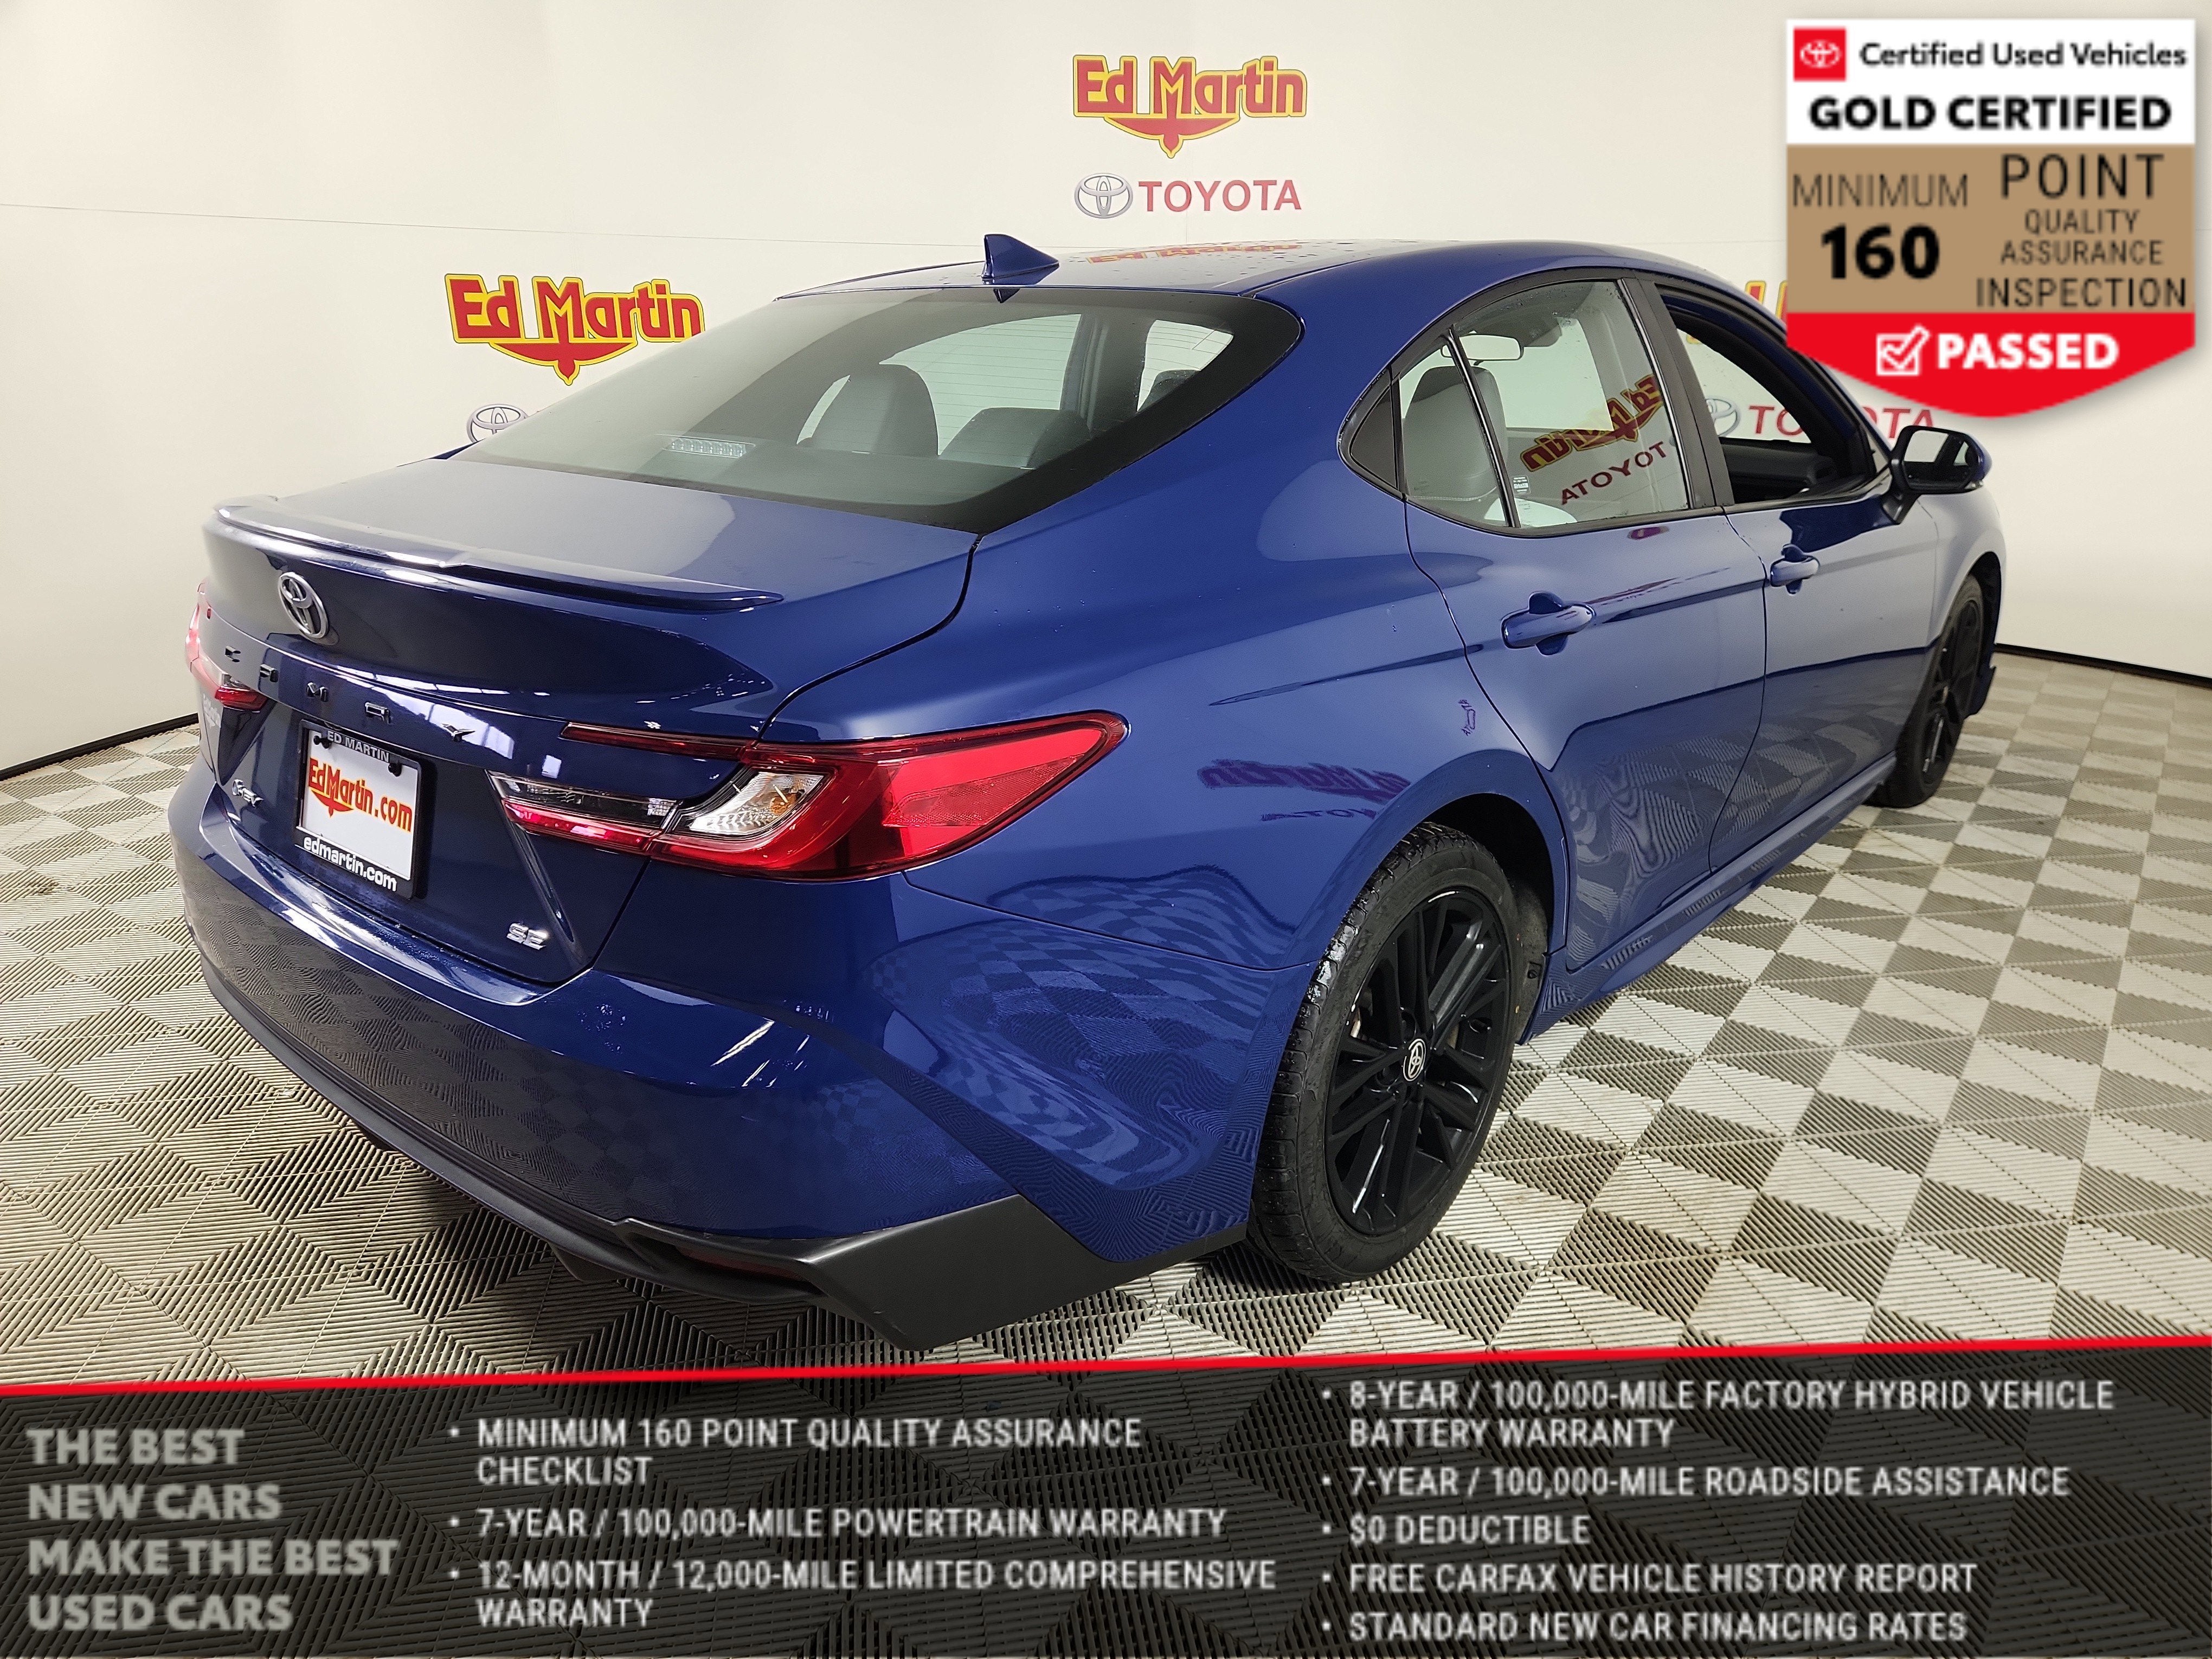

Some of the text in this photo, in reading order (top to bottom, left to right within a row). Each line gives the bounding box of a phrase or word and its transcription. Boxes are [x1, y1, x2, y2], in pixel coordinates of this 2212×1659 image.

[1073, 55, 1307, 117] Ed Martin
[1139, 179, 1302, 212] TOYOTA
[445, 273, 705, 343] Ed Martin
[327, 731, 390, 763] ED MARTIN
[304, 837, 397, 892] edmartin.com
[506, 923, 548, 950] SE
